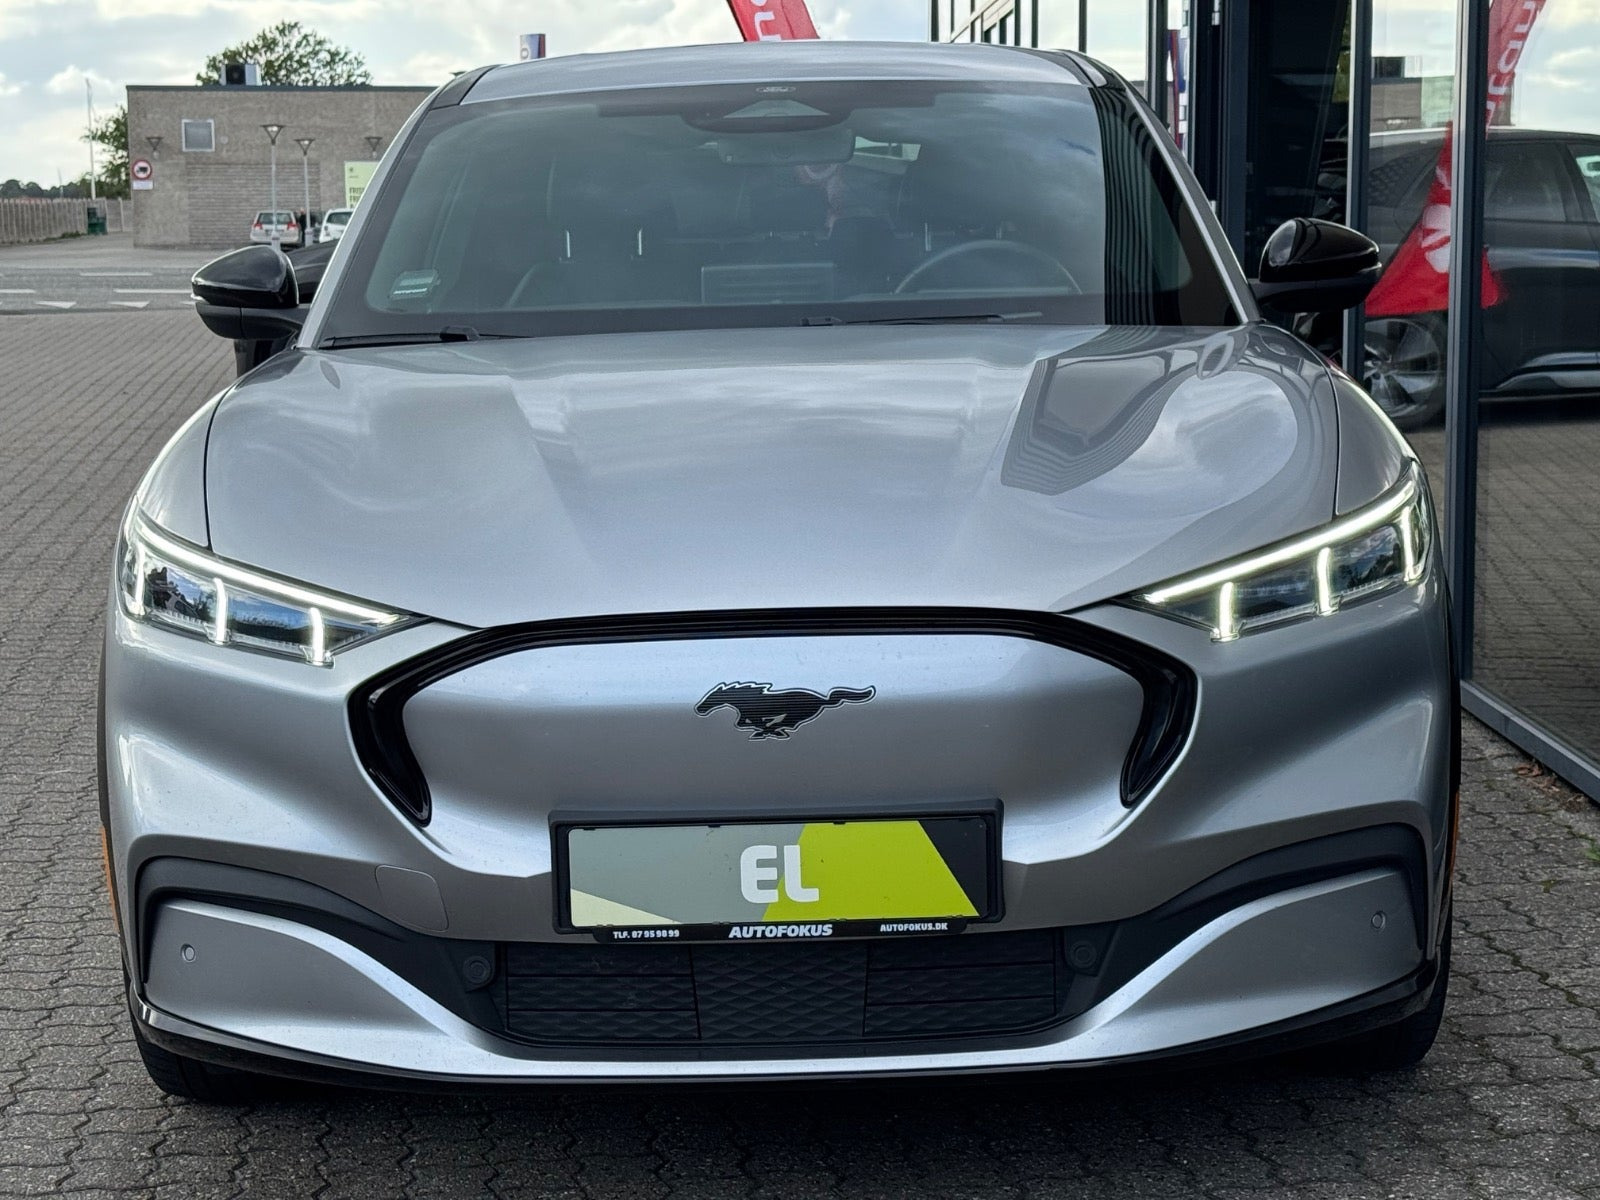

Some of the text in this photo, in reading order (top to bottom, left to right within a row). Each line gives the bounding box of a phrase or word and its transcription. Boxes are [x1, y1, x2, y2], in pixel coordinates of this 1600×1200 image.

[740, 845, 820, 903] EL
[728, 924, 833, 938] AUTOFOKUS
[880, 922, 948, 932] AUTOFOKUS.DK
[612, 931, 630, 939] TLF.
